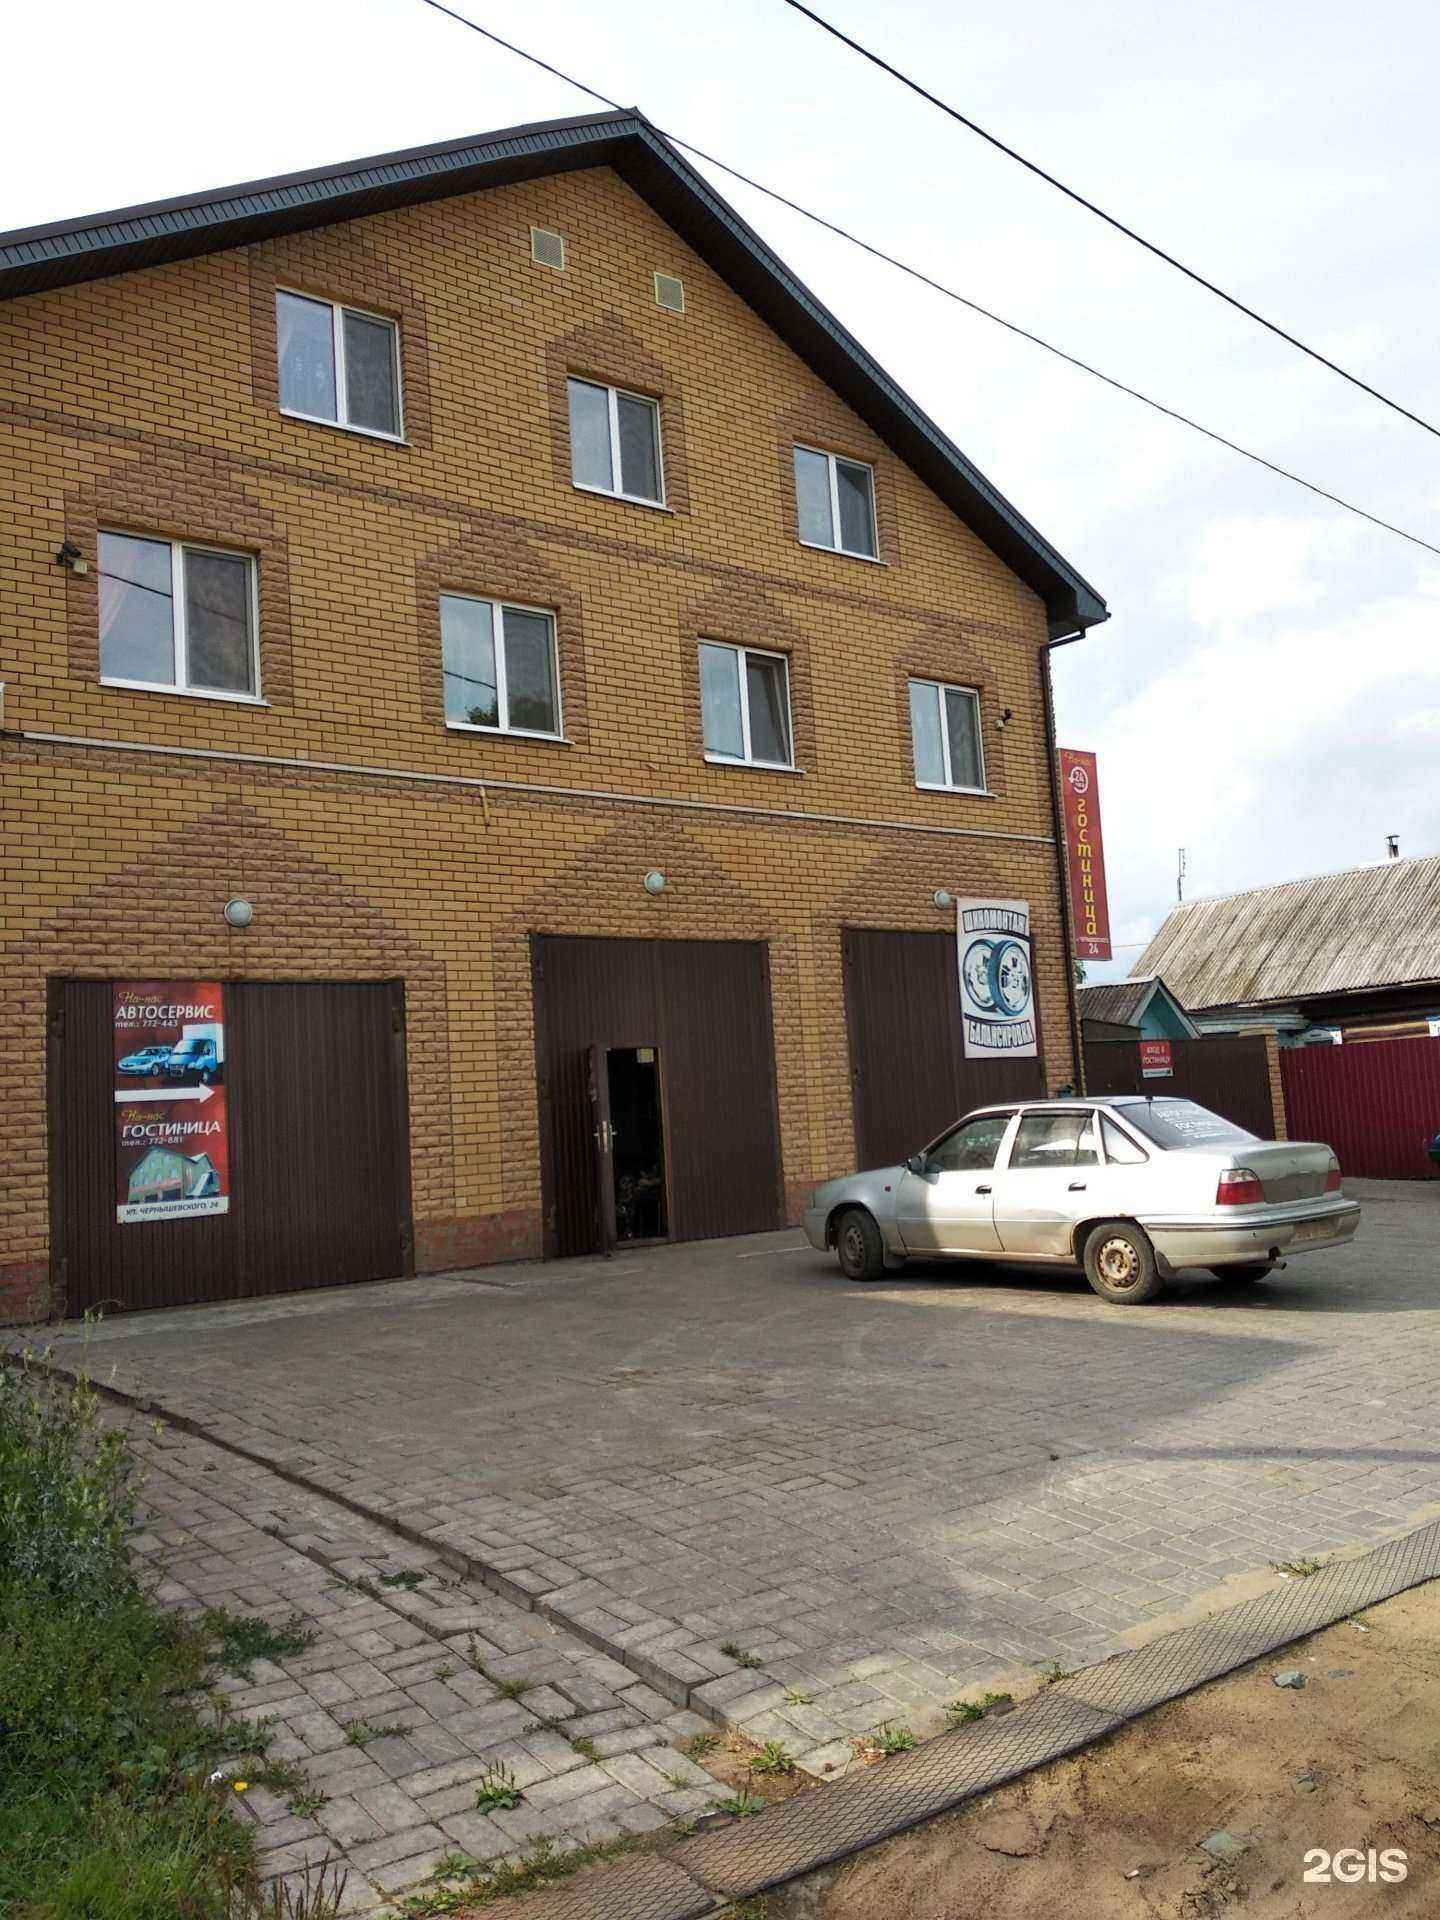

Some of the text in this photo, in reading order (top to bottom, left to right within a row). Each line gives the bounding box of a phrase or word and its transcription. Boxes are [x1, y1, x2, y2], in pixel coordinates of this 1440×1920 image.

[1089, 943, 1099, 954] 24
[115, 1004, 216, 1020] АВТОСЕРВИС
[115, 1019, 179, 1030] тел.: 772-443
[122, 1120, 222, 1139] ГОСТИНИЦА
[148, 1136, 184, 1146] 772-881
